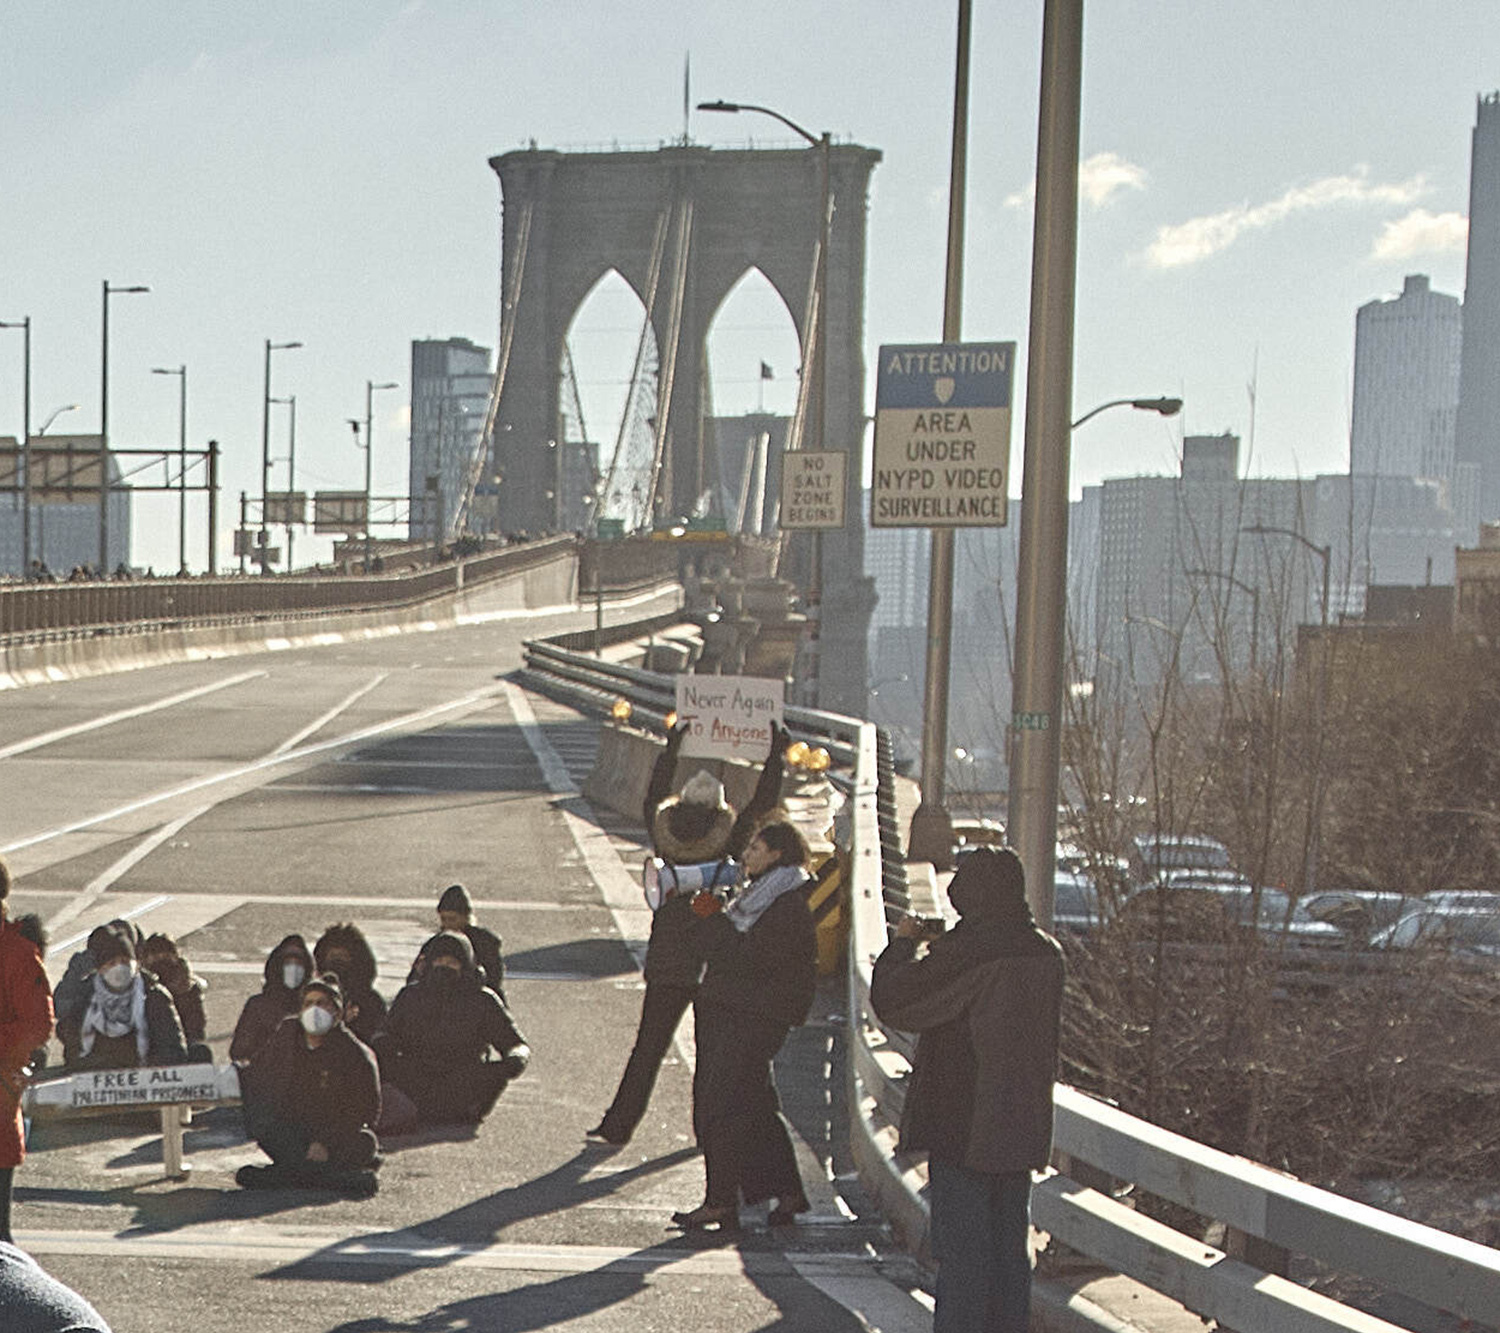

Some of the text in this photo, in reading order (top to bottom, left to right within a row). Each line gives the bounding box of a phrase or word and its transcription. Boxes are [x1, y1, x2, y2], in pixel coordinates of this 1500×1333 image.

[888, 352, 1006, 375] ATTENTION
[914, 413, 972, 433] AREA
[906, 440, 976, 461] UNDER
[804, 457, 824, 471] NO
[794, 474, 832, 488] SALT
[878, 468, 1003, 490] NYPD VIDEO
[792, 491, 833, 505] ZONE
[879, 499, 999, 518] SURVEILLANCE
[685, 687, 774, 717] Never Again
[682, 715, 769, 747] To Anyone
[93, 1070, 182, 1088] FREE ALL
[73, 1084, 215, 1105] PALESTINIAN PRISONERS
